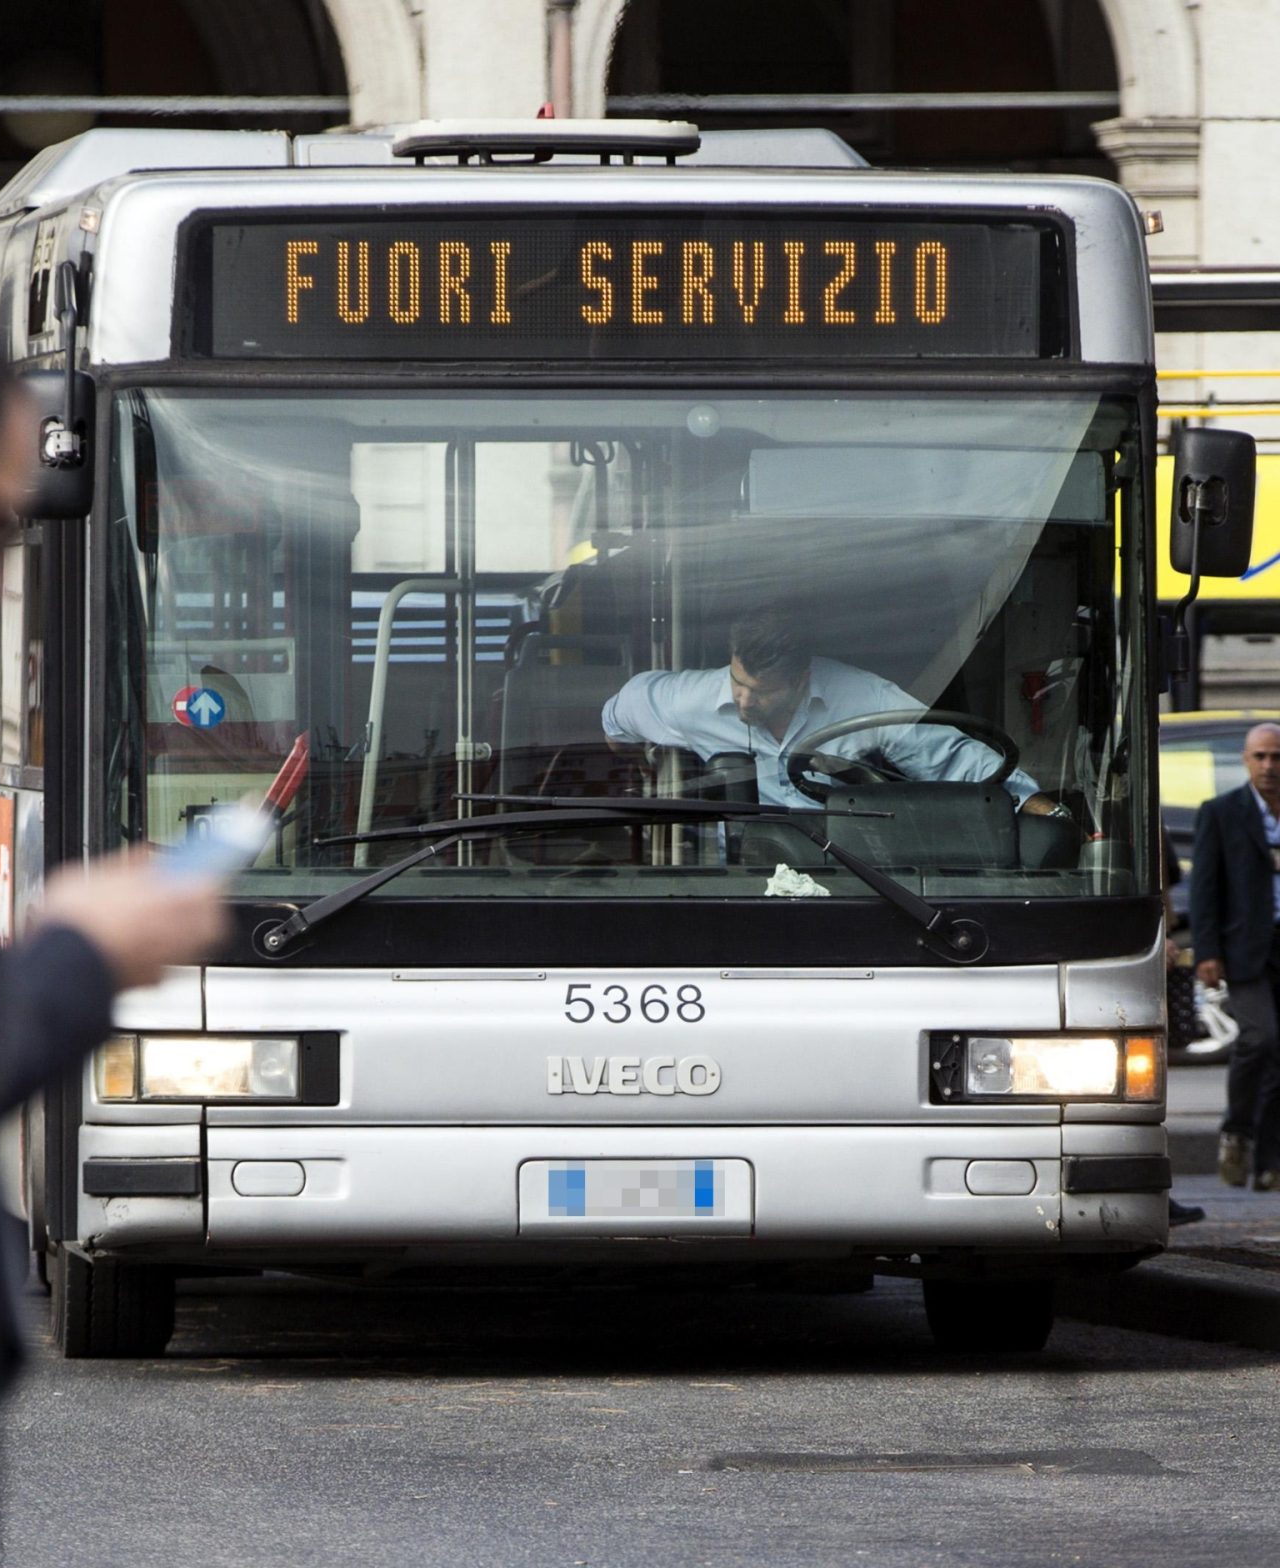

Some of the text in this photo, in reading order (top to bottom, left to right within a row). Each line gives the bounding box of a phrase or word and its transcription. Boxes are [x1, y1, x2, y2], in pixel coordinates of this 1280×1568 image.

[286, 241, 946, 323] FUORI SERVIZIO
[564, 984, 706, 1023] 5368
[547, 1055, 722, 1095] IVECO
